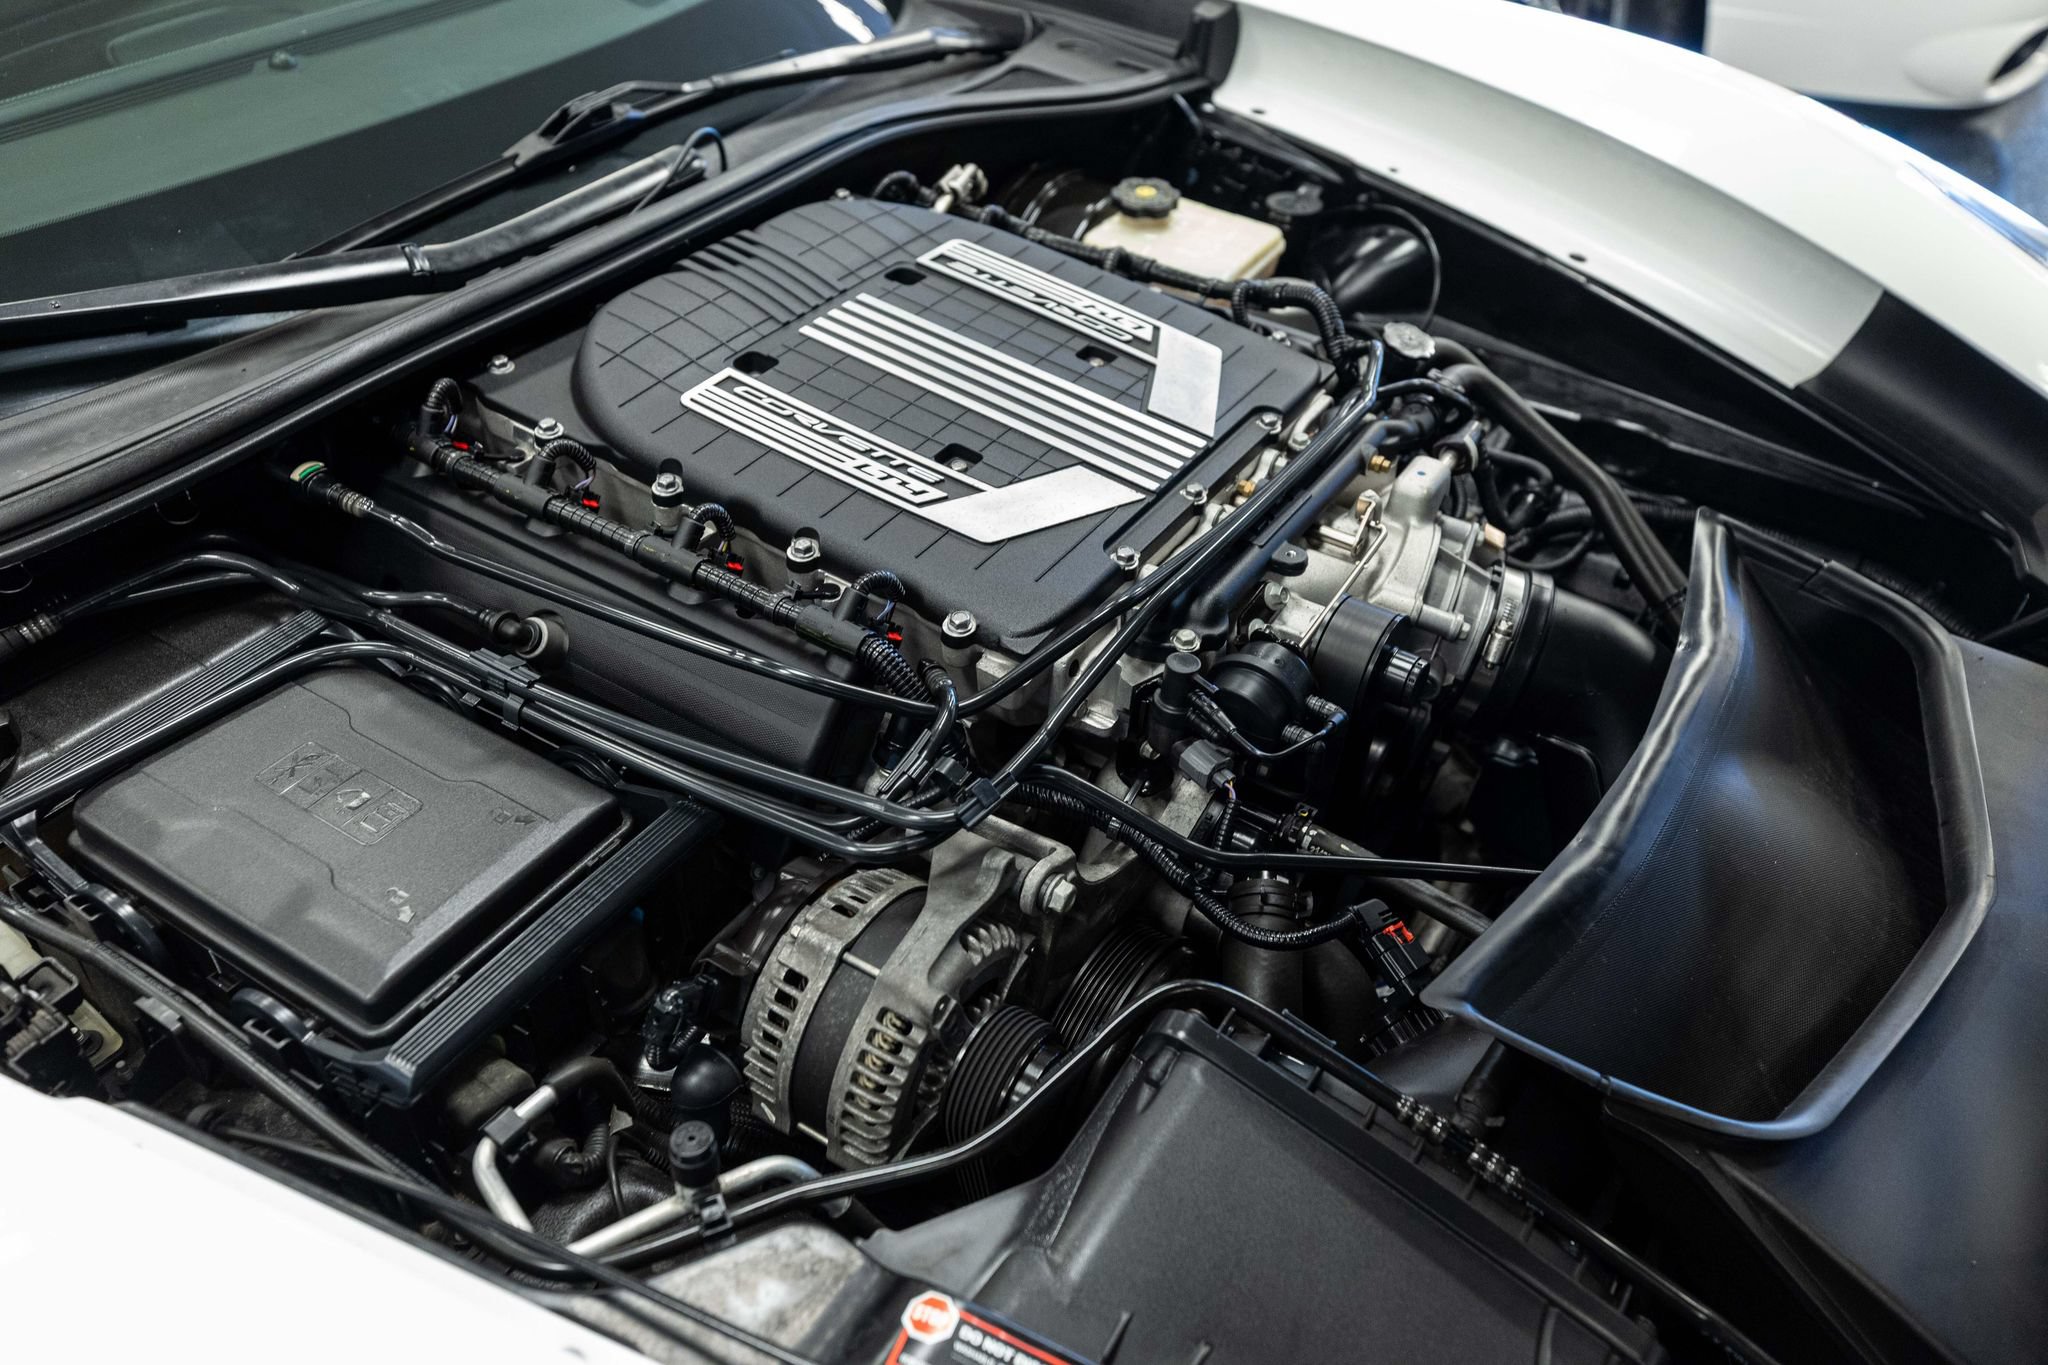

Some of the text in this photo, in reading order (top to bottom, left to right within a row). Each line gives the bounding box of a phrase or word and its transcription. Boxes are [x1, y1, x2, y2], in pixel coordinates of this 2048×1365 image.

[733, 386, 945, 484] CORVETTE
[853, 463, 930, 496] LT4
[958, 1324, 983, 1347] DO
[981, 1335, 1016, 1362] NOT
